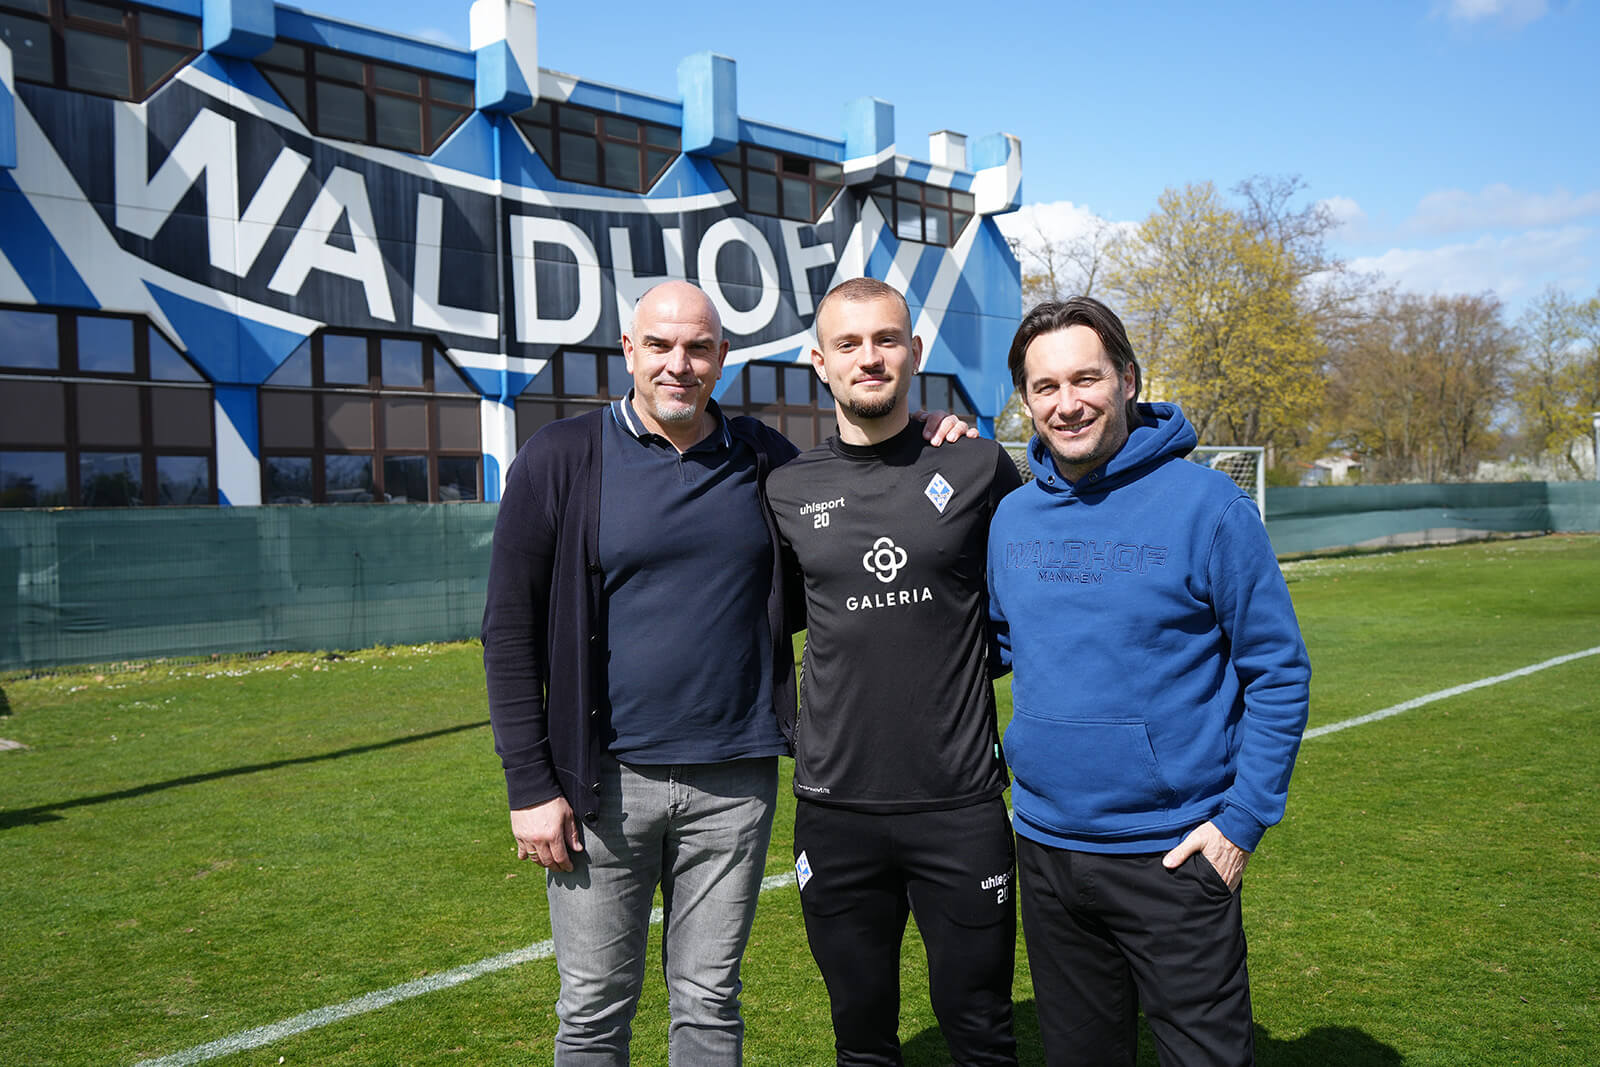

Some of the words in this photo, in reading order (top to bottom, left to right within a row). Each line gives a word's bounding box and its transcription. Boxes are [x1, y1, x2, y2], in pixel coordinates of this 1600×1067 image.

[115, 101, 836, 345] WALDHOF
[800, 496, 846, 516] uhlsport
[813, 512, 830, 529] 20
[1005, 539, 1169, 575] WALDHOF
[1037, 570, 1104, 585] MANNHEIM
[846, 587, 933, 611] GALERIA
